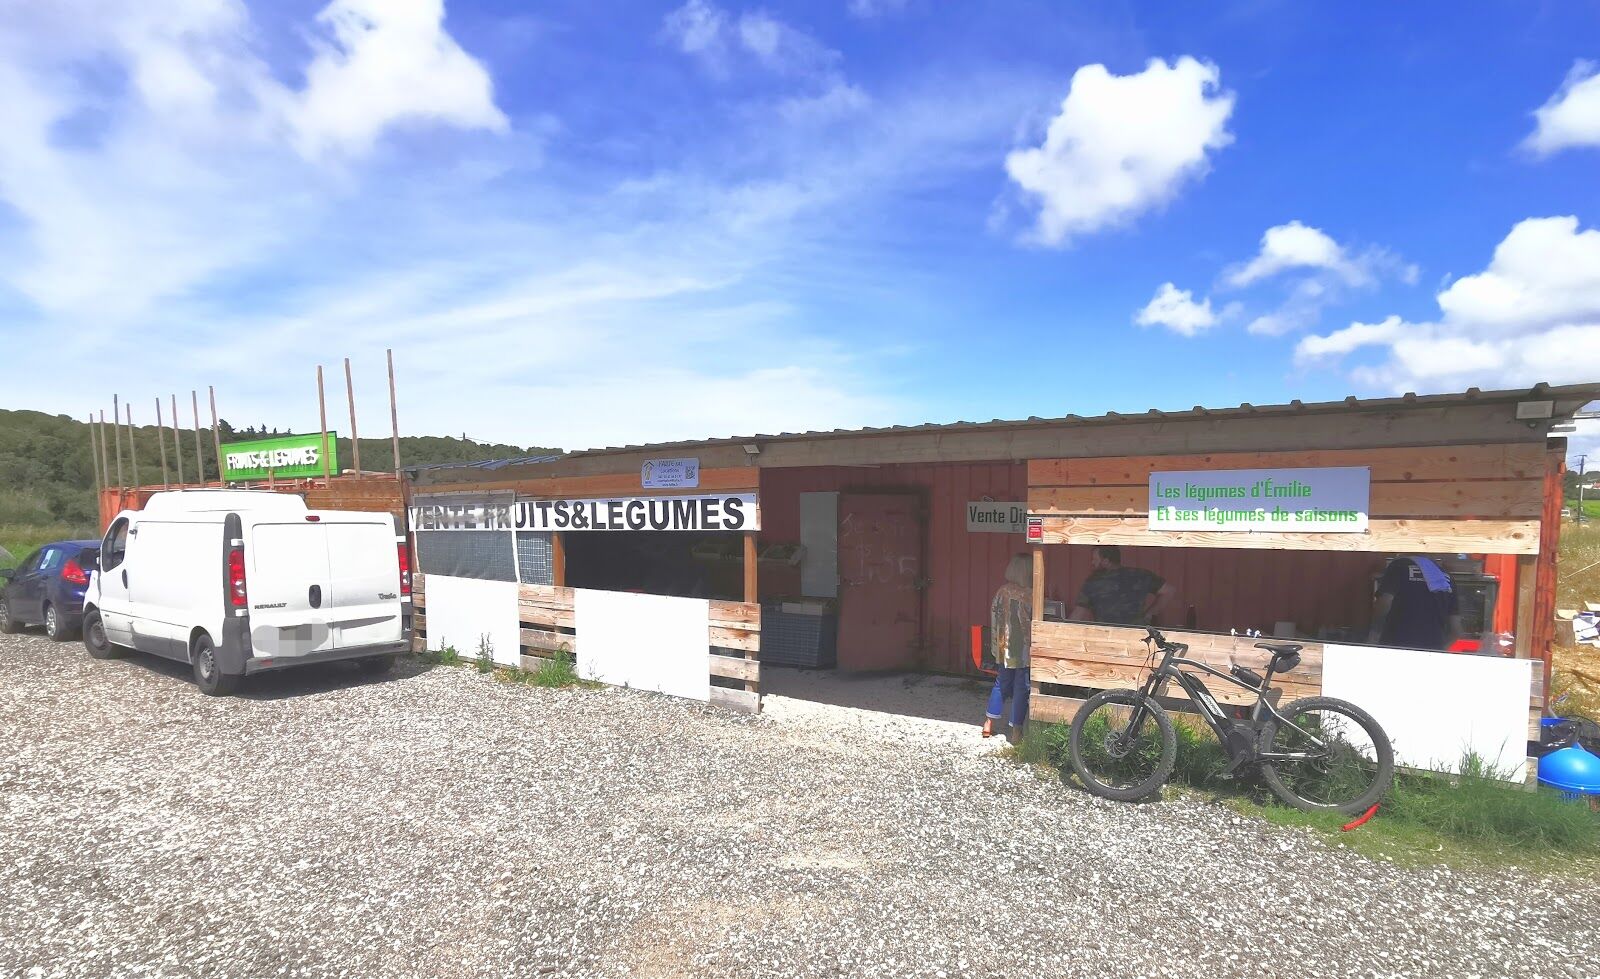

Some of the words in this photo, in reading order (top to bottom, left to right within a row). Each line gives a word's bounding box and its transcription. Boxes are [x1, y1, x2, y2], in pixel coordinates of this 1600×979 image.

[1156, 482, 1181, 499] Les
[1185, 484, 1246, 502] légumes
[1251, 478, 1312, 498] d'Émilie
[408, 504, 477, 530] VENTE
[483, 497, 745, 531] FRUITS&LEGUMES
[969, 506, 1005, 523] Vente
[1156, 506, 1170, 521] Et
[1175, 510, 1198, 521] ses
[1204, 506, 1265, 524] légumes
[1271, 506, 1288, 521] de
[1295, 507, 1358, 522] saisons
[254, 602, 287, 610] RENAULT
